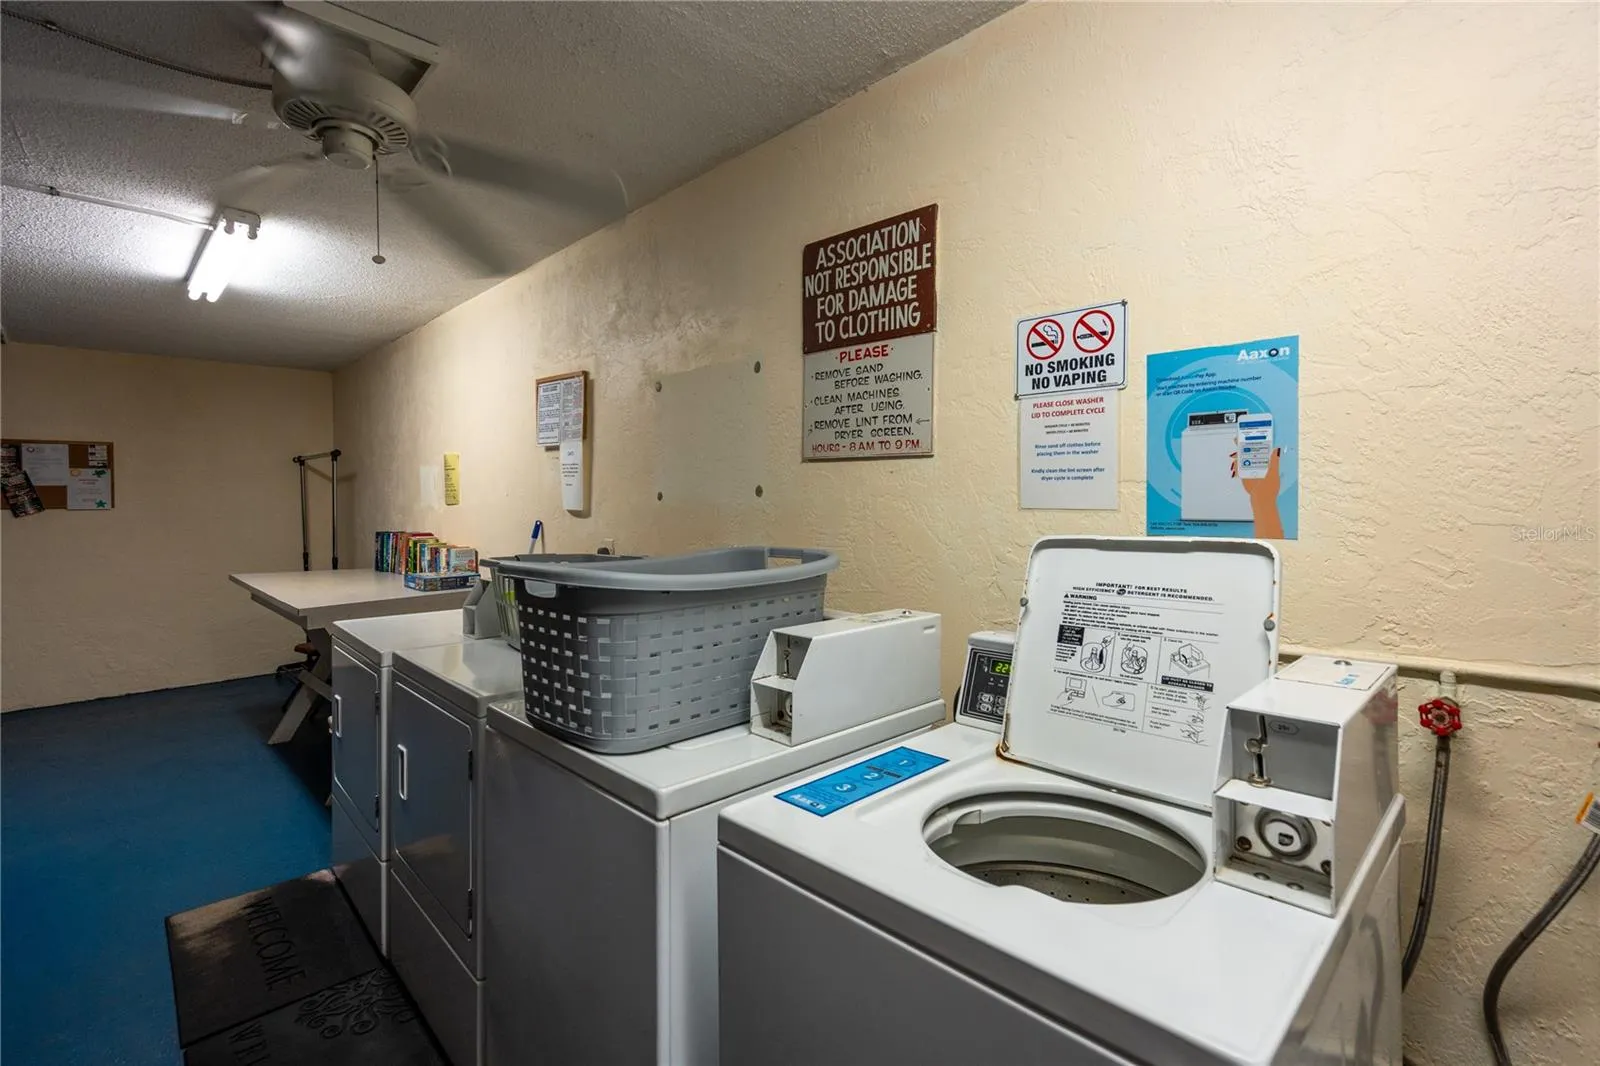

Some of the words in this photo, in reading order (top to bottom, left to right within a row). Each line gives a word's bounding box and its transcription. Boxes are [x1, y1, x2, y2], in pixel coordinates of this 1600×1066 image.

[816, 217, 920, 270] ASSOCIATION
[805, 271, 832, 298] NOT
[835, 242, 932, 290] RESPONSIBLE
[817, 292, 845, 319] FOR
[849, 274, 917, 312] DAMAGE
[815, 320, 835, 343] TO
[840, 302, 921, 339] CLOTHING
[840, 344, 889, 363] PLEASE
[1236, 346, 1290, 361] Aaxon
[815, 367, 851, 381] REMOVE
[855, 363, 884, 375] SAND
[1025, 363, 1043, 376] NO
[1047, 353, 1115, 374] SMOKING
[834, 376, 870, 389] BEFORE
[1032, 376, 1050, 390] NO
[1053, 369, 1107, 387] VAPING
[814, 394, 843, 406] CLEAN
[1075, 397, 1104, 405] WASHER
[834, 403, 864, 415] AFTER
[1051, 408, 1084, 417] COMPLETE
[814, 418, 850, 430] REMOVE
[856, 416, 879, 428] LINT
[882, 413, 913, 425] FROM
[834, 429, 864, 440] DRYER
[870, 427, 914, 438] SCREEN.
[812, 442, 840, 453] HOURS
[849, 442, 856, 451] 8
[858, 441, 875, 451] AM
[879, 440, 891, 450] TO
[895, 440, 903, 450] 9
[237, 896, 307, 992] WELCOME
